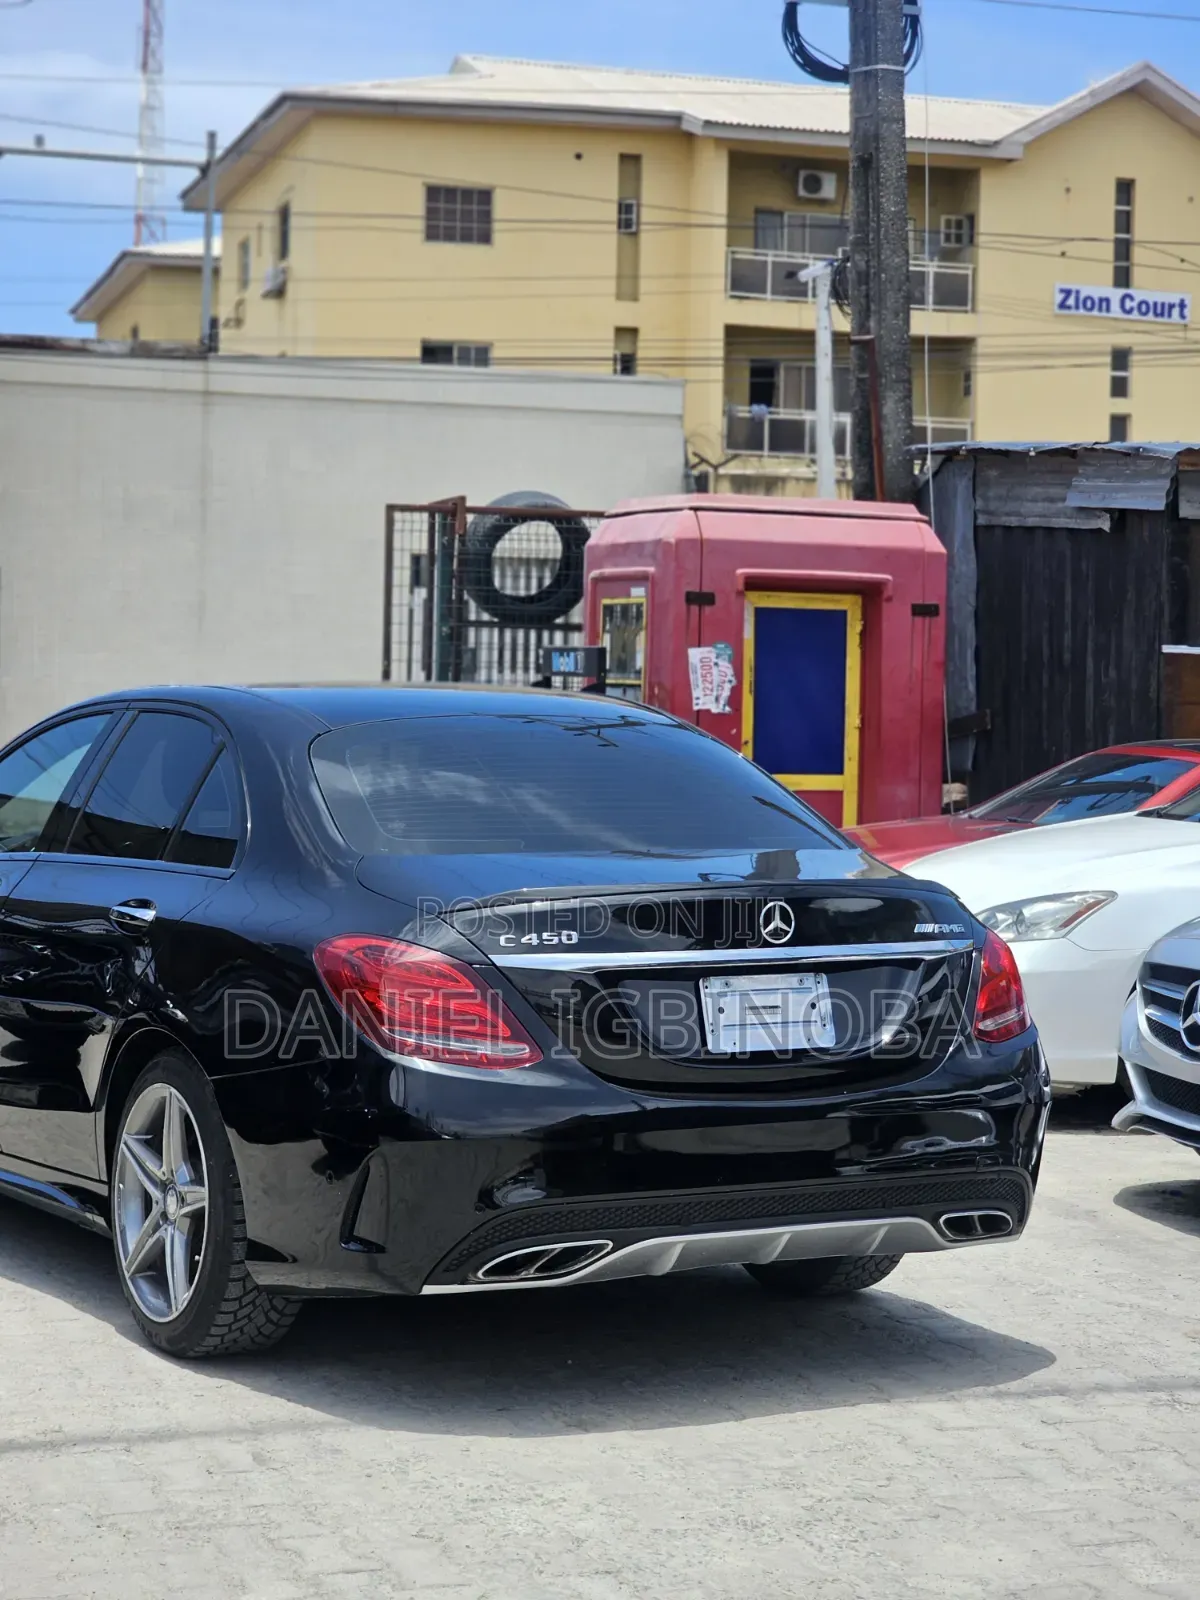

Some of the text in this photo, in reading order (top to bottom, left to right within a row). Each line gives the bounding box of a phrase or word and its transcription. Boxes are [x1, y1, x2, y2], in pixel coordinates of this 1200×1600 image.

[1057, 288, 1188, 320] Zion Court
[700, 656, 714, 697] 122500
[499, 930, 579, 947] C 450
[933, 923, 966, 934] AMG
